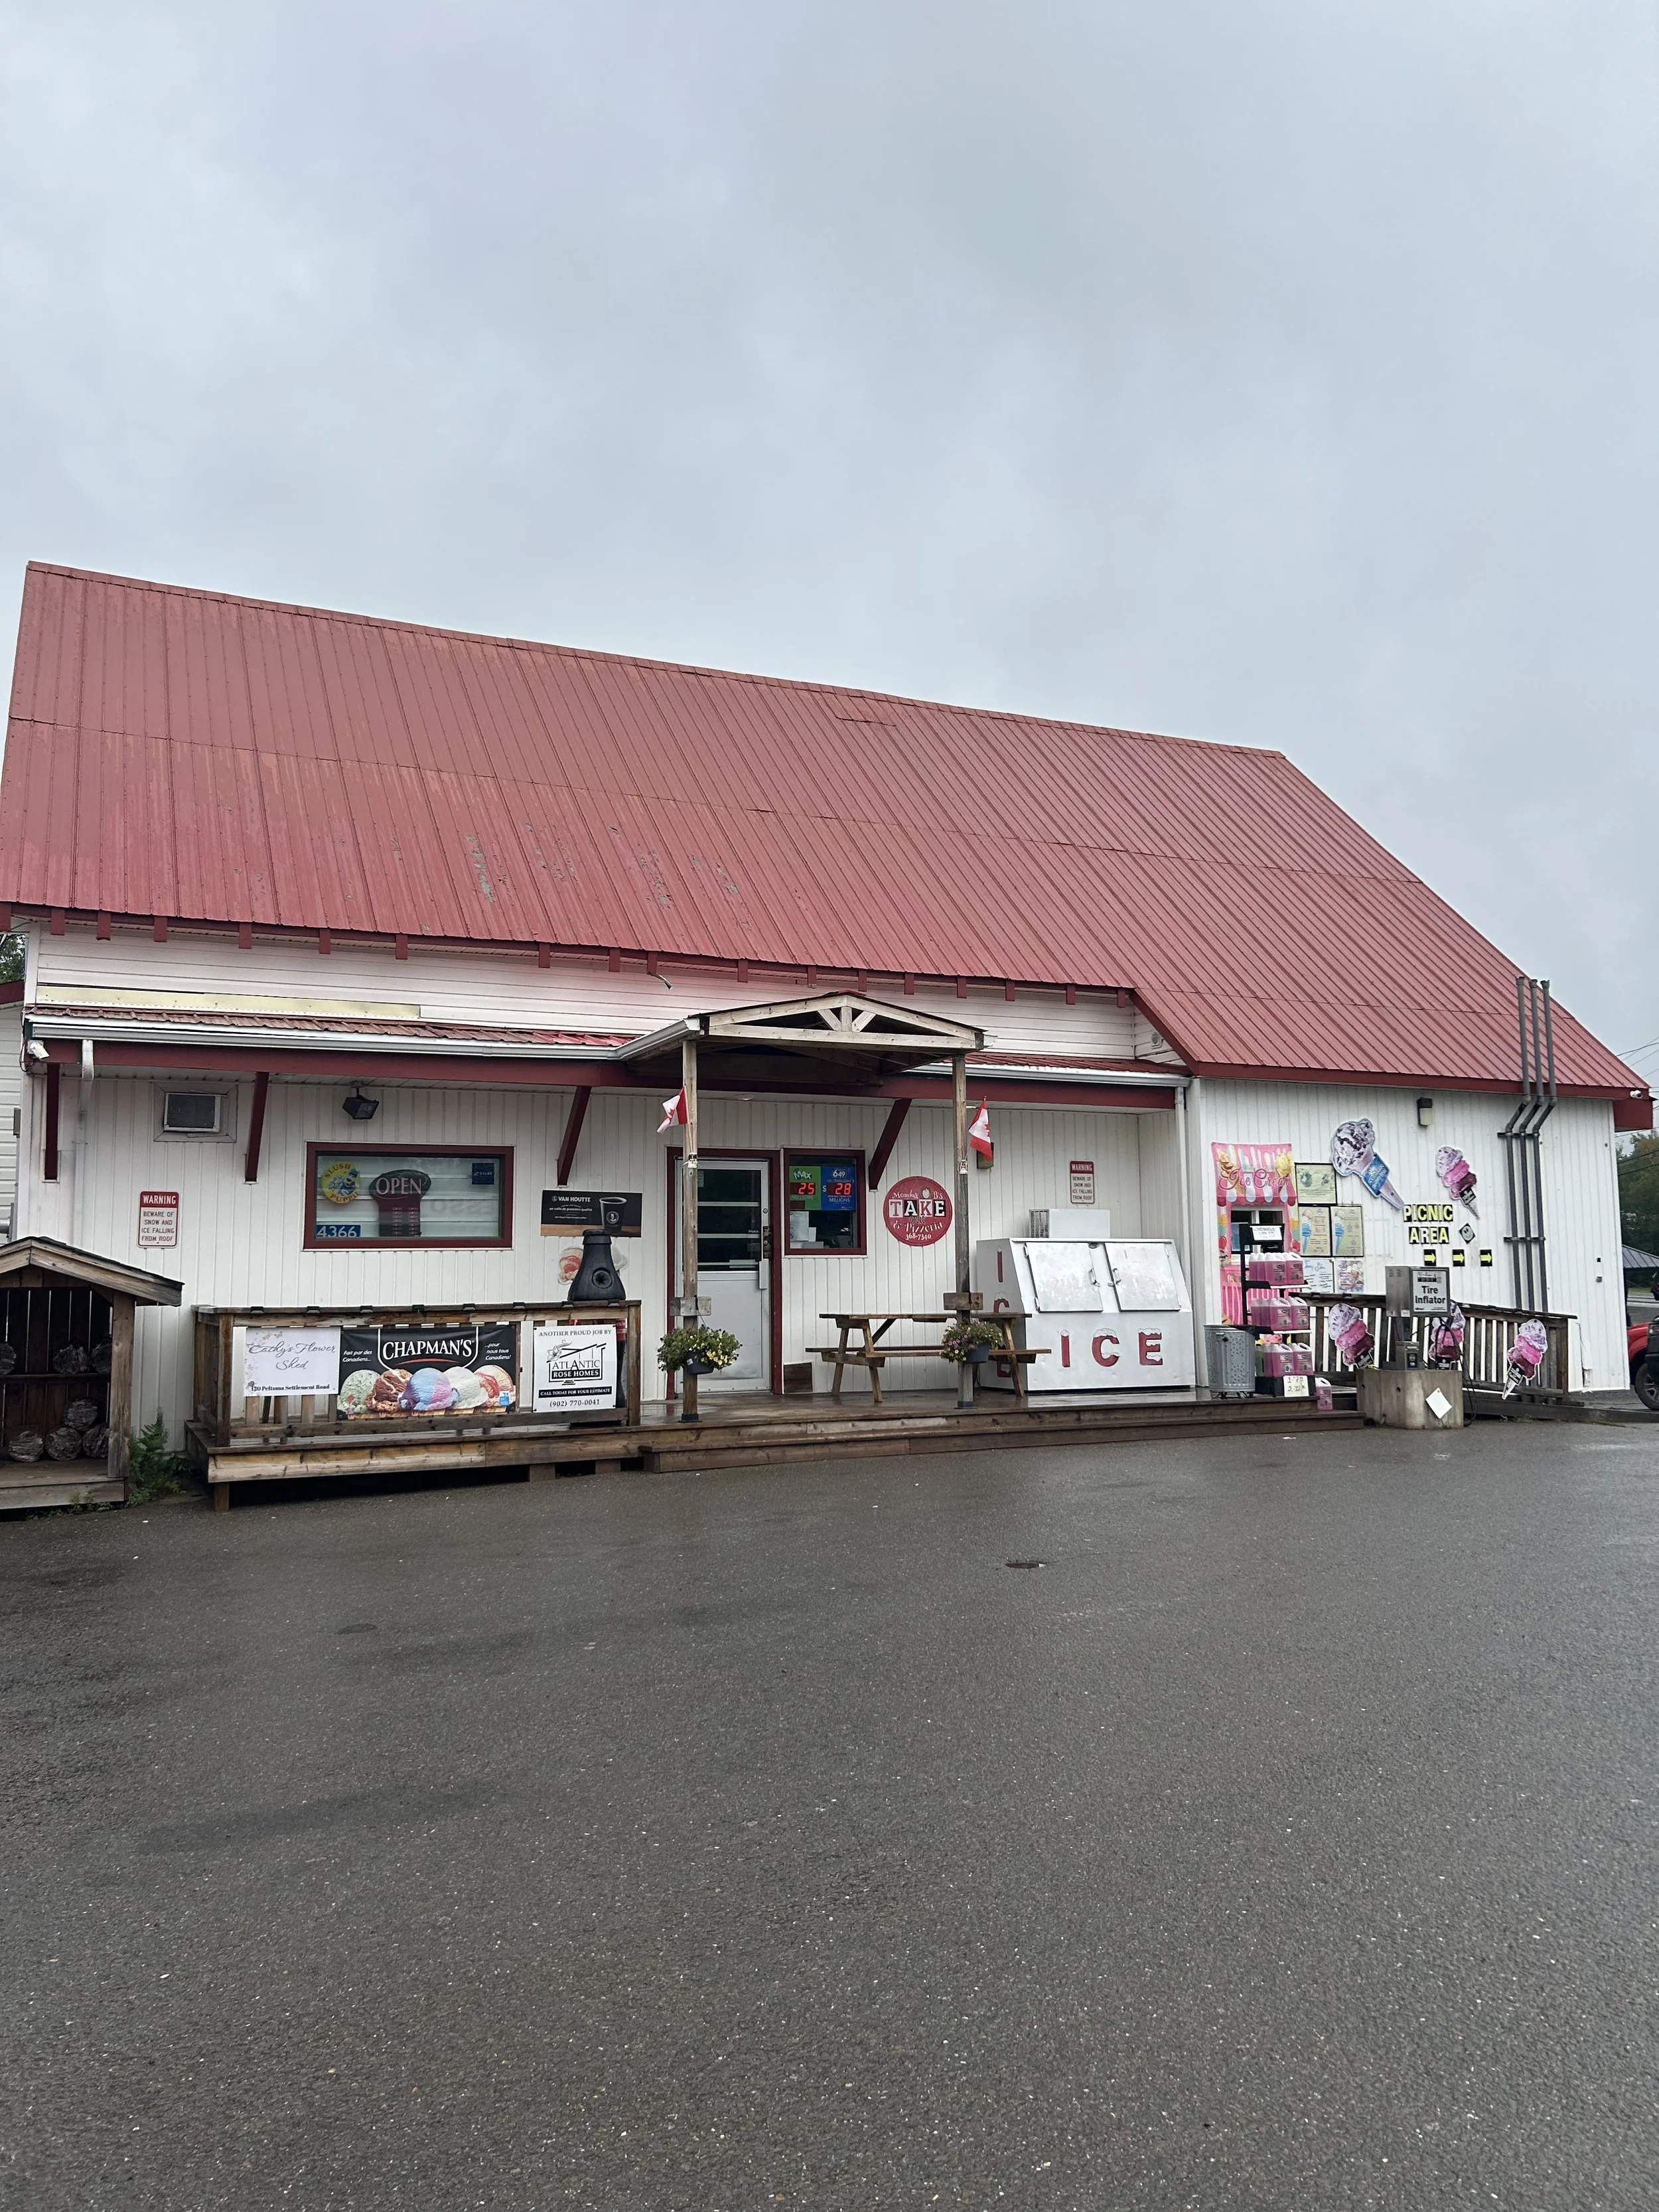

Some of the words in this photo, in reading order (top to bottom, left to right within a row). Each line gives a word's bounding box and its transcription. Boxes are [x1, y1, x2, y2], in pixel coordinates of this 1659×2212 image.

[325, 1163, 351, 1178] SLUSH
[794, 1170, 812, 1179] MAX
[832, 1169, 846, 1178] 649
[1219, 1167, 1251, 1190] Ice
[1253, 1168, 1291, 1188] Cream
[376, 1177, 423, 1195] OPEN
[798, 1183, 815, 1195] 25
[835, 1183, 852, 1195] 28
[143, 1195, 176, 1205] WARNING
[932, 1191, 943, 1199] B's
[890, 1200, 946, 1217] TAKE
[1404, 1205, 1453, 1222] PICNIC
[317, 1225, 357, 1237] 4366
[905, 1221, 943, 1232] Pizzeria
[1409, 1227, 1449, 1244] AREA
[1421, 1285, 1439, 1294] Tire
[1415, 1295, 1446, 1304] Inflator
[295, 1341, 336, 1354] Flower
[383, 1339, 472, 1361] CHAPMAN'S
[1060, 1327, 1163, 1368] ICE
[276, 1357, 309, 1370] Shed
[552, 1360, 601, 1370] ATLANTIC
